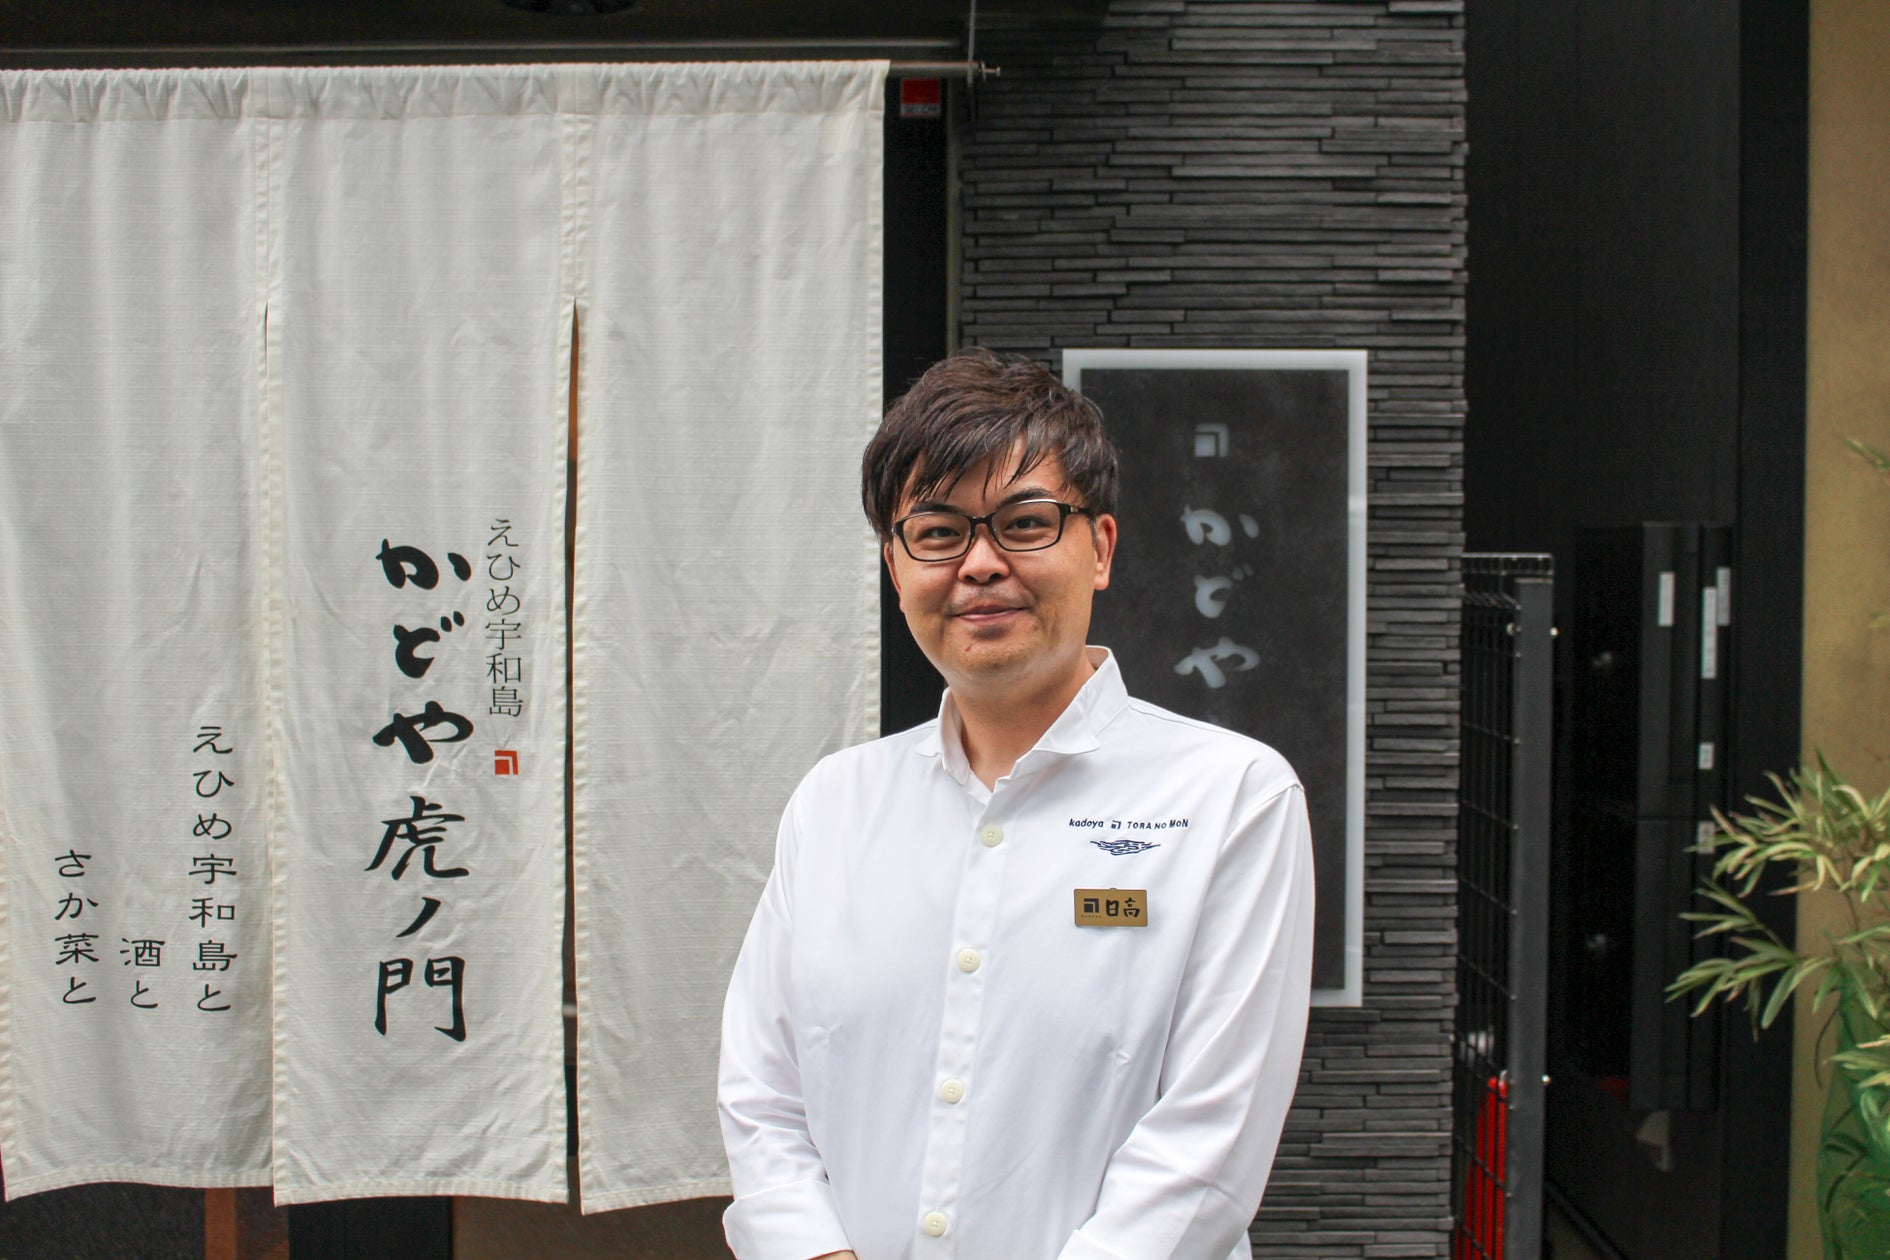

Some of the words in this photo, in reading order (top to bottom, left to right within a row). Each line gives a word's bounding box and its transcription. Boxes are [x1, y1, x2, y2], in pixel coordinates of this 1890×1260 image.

[485, 518, 524, 718] えひめ宇和島
[1173, 505, 1261, 689] かどや
[188, 726, 238, 1012] えひめ宇和島と
[364, 538, 474, 1042] かどや虎ノ門
[1069, 818, 1104, 829] kadoya
[54, 849, 100, 1005] さか菜と
[119, 937, 166, 1009] 酒と
[1105, 897, 1141, 918] 日高
